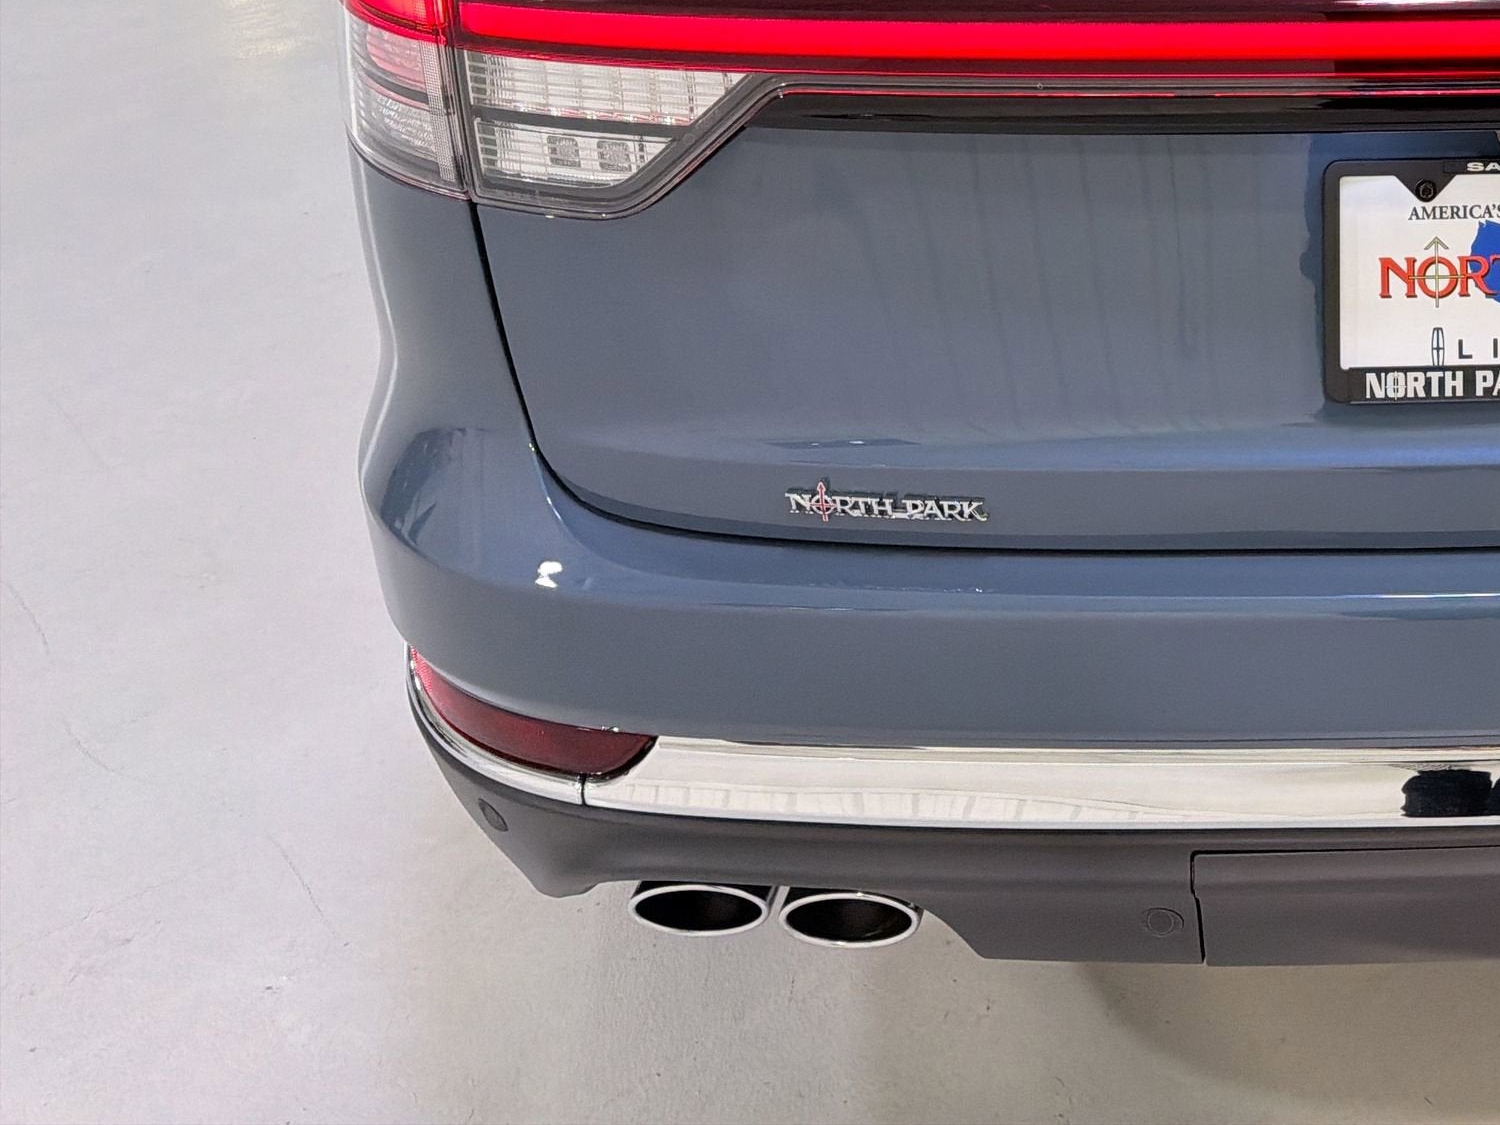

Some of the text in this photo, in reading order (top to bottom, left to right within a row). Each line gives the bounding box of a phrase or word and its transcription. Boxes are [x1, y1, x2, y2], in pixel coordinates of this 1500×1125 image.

[1365, 369, 1464, 400] NORTH
[785, 492, 988, 522] NORTH PARK
